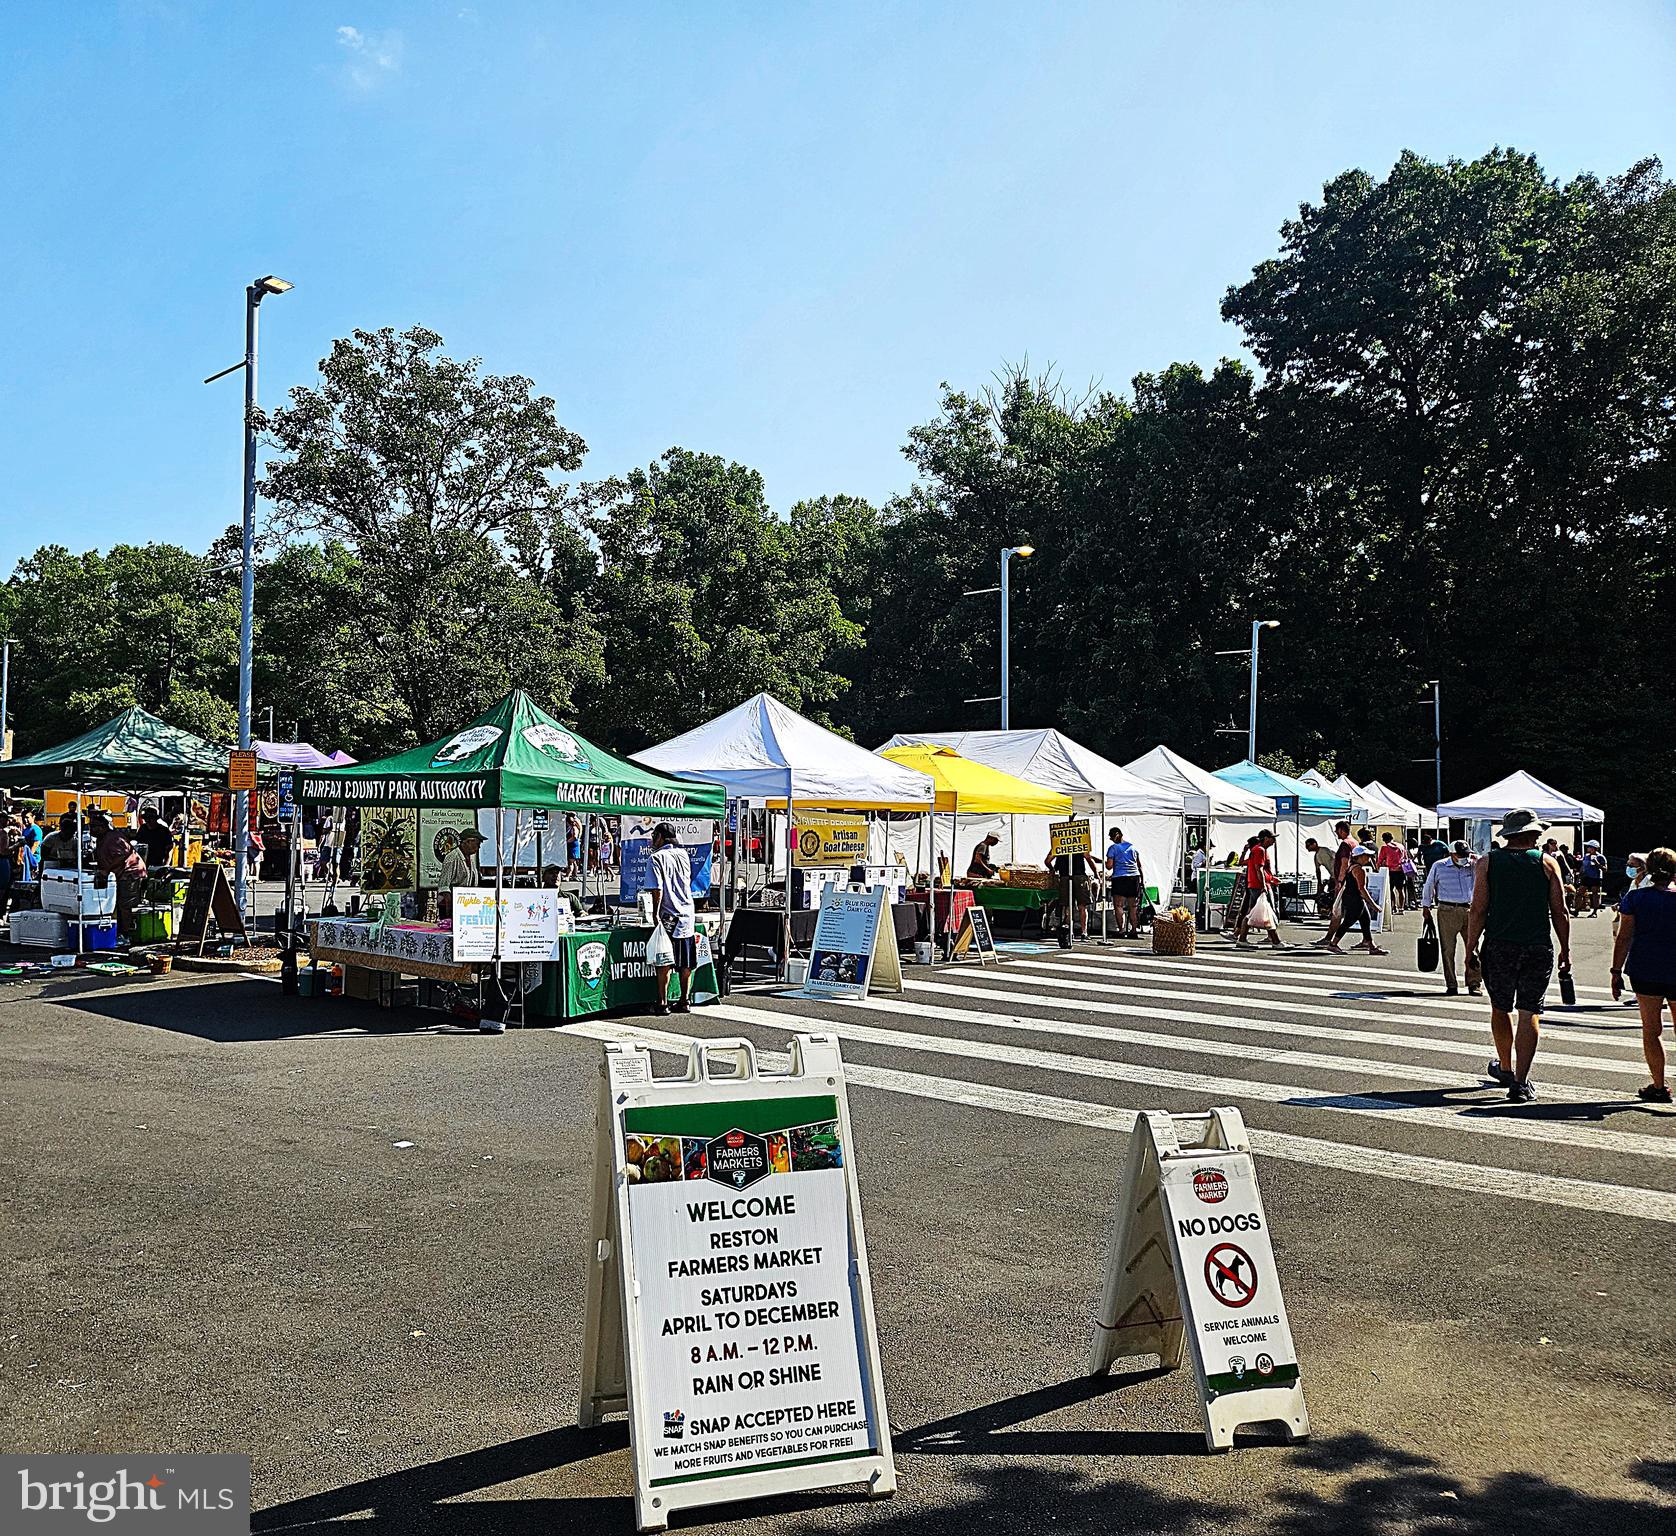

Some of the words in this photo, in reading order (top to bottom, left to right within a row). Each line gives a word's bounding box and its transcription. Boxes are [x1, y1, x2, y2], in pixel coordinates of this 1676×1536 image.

[302, 780, 341, 798] FAIRFAX
[345, 781, 385, 799] COUNTY
[389, 781, 417, 799] PARK
[420, 780, 486, 799] AUTHORITY
[557, 782, 606, 805] MARKET
[609, 786, 686, 809] INFORMATION
[362, 807, 415, 820] VIRGINIA
[832, 830, 858, 840] Artisan
[1052, 827, 1089, 838] ARTISAN
[1060, 836, 1082, 846] GOAT
[824, 842, 841, 852] Goat
[841, 841, 865, 852] Cheese
[1055, 844, 1088, 855] CHEESE
[859, 900, 876, 908] RIDGE
[460, 914, 497, 926] FESTIV
[623, 941, 645, 958] MAR
[610, 961, 657, 981] INFORMA
[716, 1147, 759, 1159] FARMERS
[713, 1157, 763, 1170] MARKETS
[1194, 1181, 1228, 1193] FARMERS
[1198, 1190, 1227, 1200] MARKET
[686, 1195, 795, 1222] WELCOME
[1178, 1218, 1205, 1237] NO
[1208, 1213, 1261, 1234] DOGS
[710, 1228, 778, 1249] RESTON
[668, 1255, 749, 1278] FARMERS
[754, 1247, 822, 1269] MARKET
[701, 1280, 797, 1306] SATURDAYS
[661, 1315, 712, 1336] APRIL
[715, 1311, 740, 1330] TO
[744, 1301, 839, 1327] DECEMBER
[1204, 1319, 1239, 1332] SERVICE
[1241, 1315, 1280, 1328] ANIMALS
[1223, 1332, 1267, 1346] WELCOME
[690, 1347, 701, 1363] 8
[706, 1342, 743, 1362] A.M.
[762, 1338, 780, 1355] 12
[784, 1334, 818, 1353] P.M.
[693, 1374, 734, 1395] RAIN
[738, 1370, 765, 1389] OR
[769, 1364, 822, 1386] SHINE
[690, 1417, 730, 1435] SNAP
[734, 1406, 813, 1430] ACCEPTED
[817, 1400, 856, 1419] HERE
[664, 1425, 683, 1434] SNAP
[654, 1447, 668, 1457] WE
[670, 1442, 701, 1455] MATCH
[703, 1440, 726, 1450] SNAP
[728, 1433, 768, 1447] BENEFITS
[770, 1432, 783, 1441] SO
[785, 1429, 803, 1439] YOU
[805, 1426, 823, 1436] CAN
[824, 1420, 868, 1434] PURCHASE
[674, 1460, 701, 1470] MORE
[703, 1453, 733, 1465] FRUITS
[735, 1450, 753, 1461] AND
[755, 1443, 808, 1458] VEGETABLES
[810, 1441, 828, 1450] FOR
